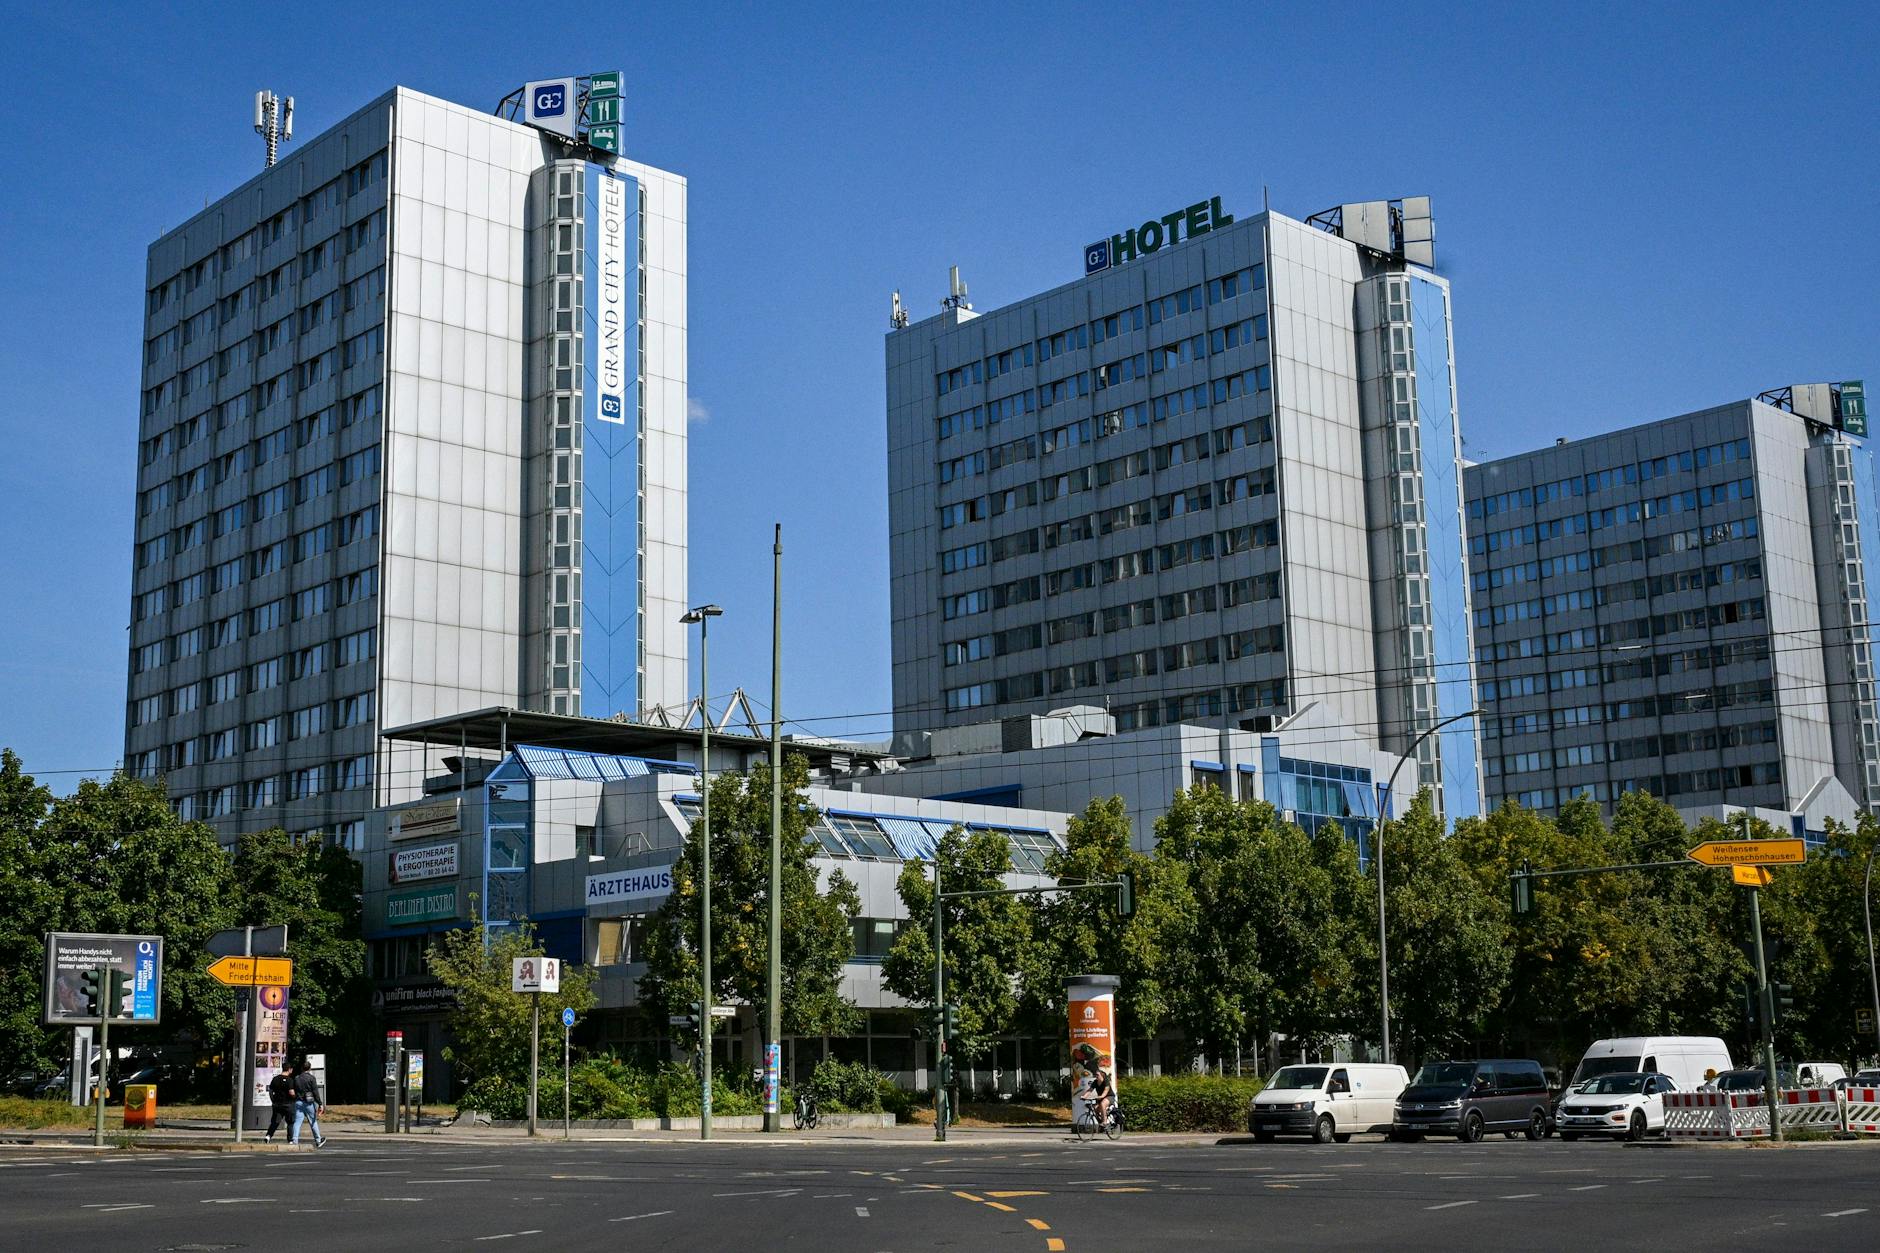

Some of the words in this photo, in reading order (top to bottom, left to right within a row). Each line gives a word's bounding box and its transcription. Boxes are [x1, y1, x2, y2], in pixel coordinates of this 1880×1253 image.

[605, 185, 619, 248] HOTEL
[1112, 196, 1234, 267] HOTEL
[605, 253, 619, 304] CITY
[604, 310, 619, 388] GRAND
[399, 846, 454, 861] PHYSIOTHERAPIE
[403, 856, 454, 871] ERGOTHERAPIE
[588, 873, 669, 897] ÄRZTEHAUS
[388, 897, 425, 917] BERLINER
[427, 893, 454, 913] BISTRO
[79, 948, 98, 956] Handys
[229, 962, 248, 970] Mitte
[229, 972, 284, 982] Friedrichshain
